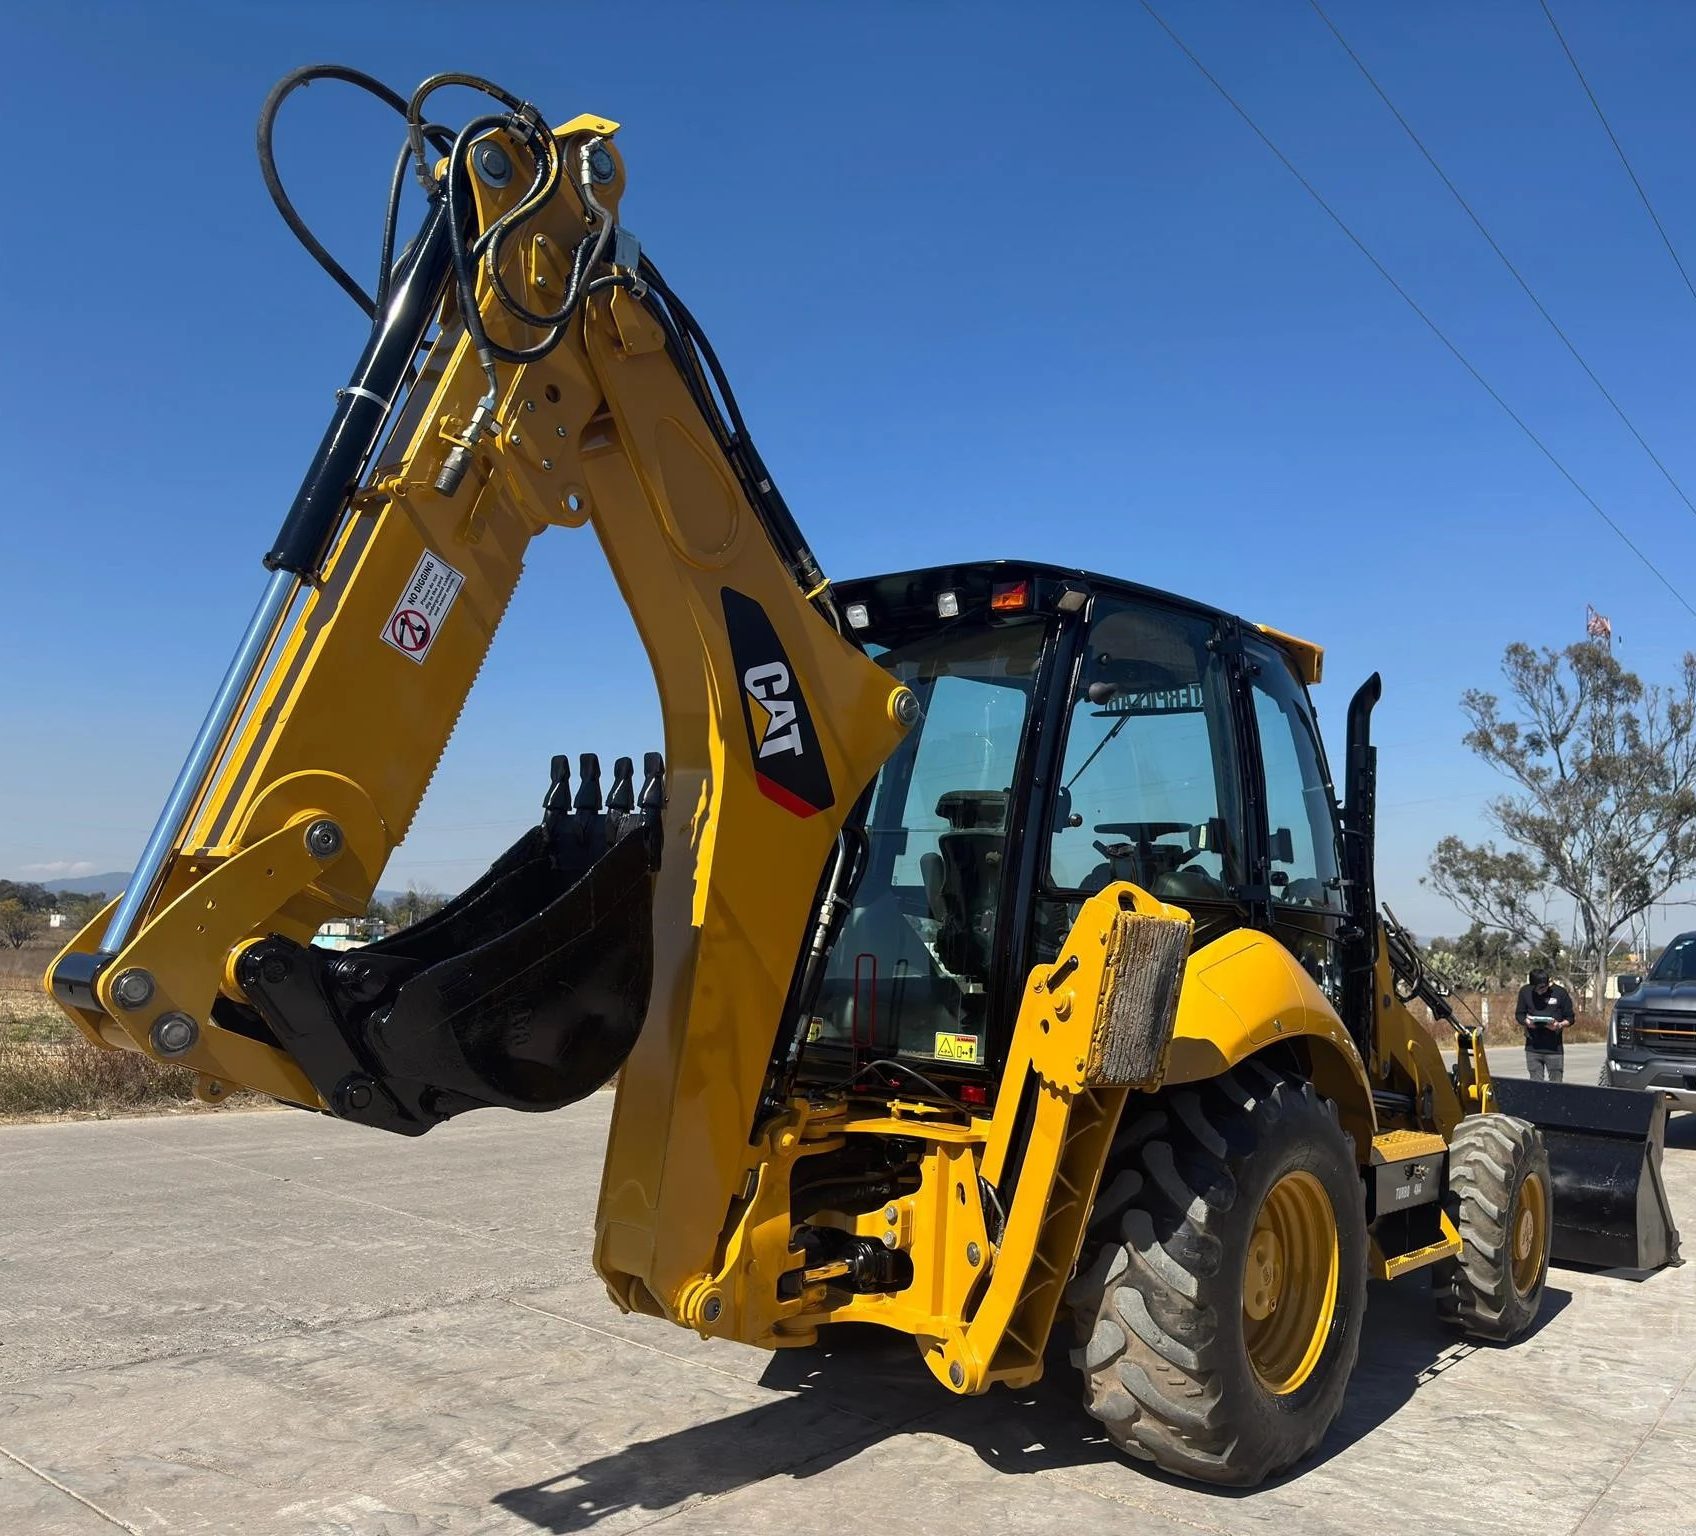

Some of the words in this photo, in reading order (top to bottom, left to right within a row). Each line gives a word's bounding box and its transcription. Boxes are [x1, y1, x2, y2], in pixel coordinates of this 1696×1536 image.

[407, 592, 418, 606] NO
[413, 560, 435, 593] DIGGING
[745, 662, 803, 758] CAT
